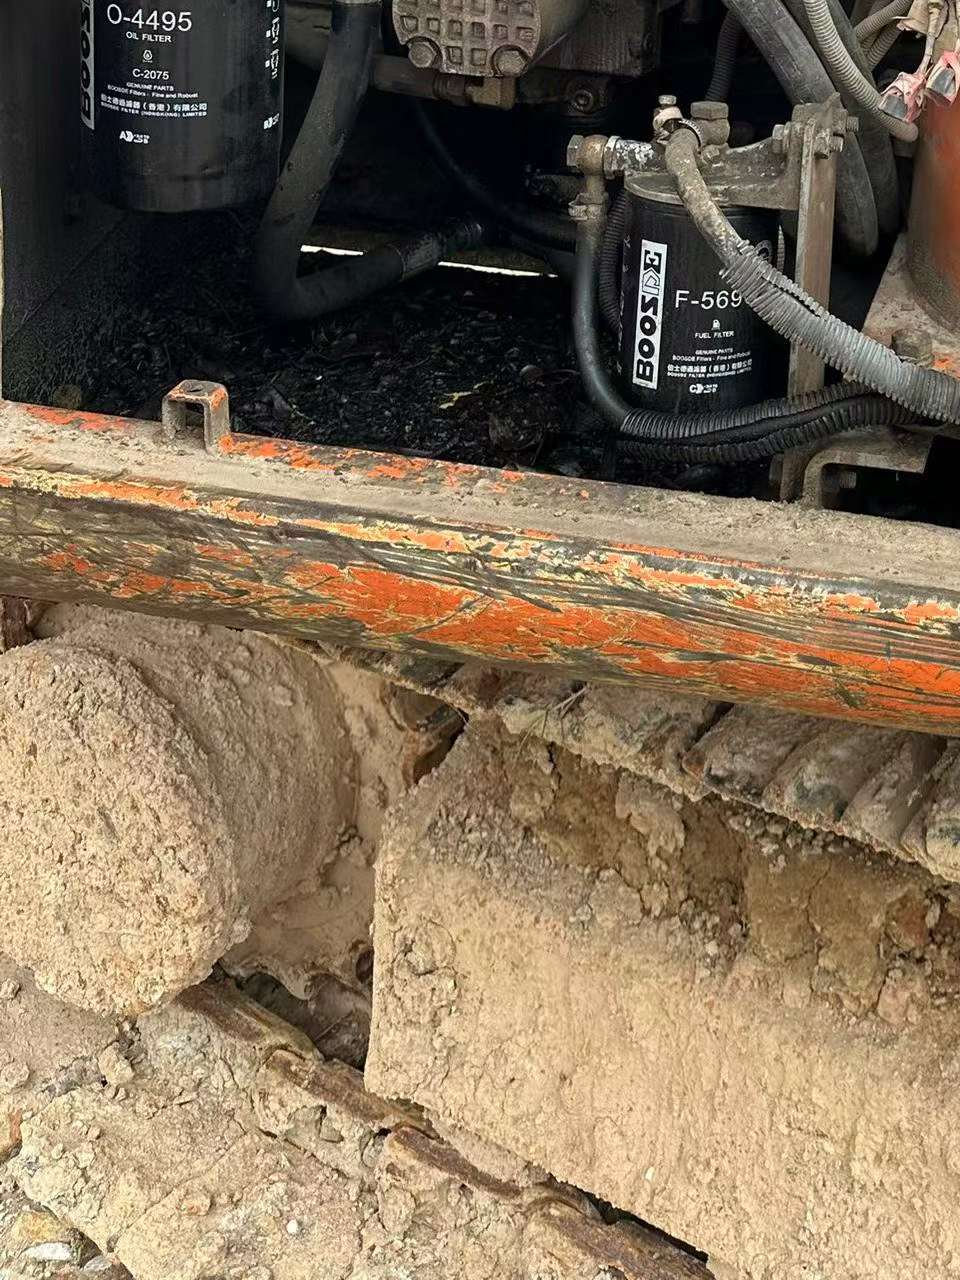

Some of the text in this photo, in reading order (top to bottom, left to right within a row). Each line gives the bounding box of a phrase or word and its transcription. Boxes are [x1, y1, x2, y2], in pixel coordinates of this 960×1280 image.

[126, 31, 172, 42] OIL FILTER
[132, 68, 169, 80] C-2075
[126, 82, 152, 90] GENUINE
[675, 289, 742, 309] F-569
[635, 249, 662, 383] BOOSDE
[713, 330, 734, 338] FILTER
